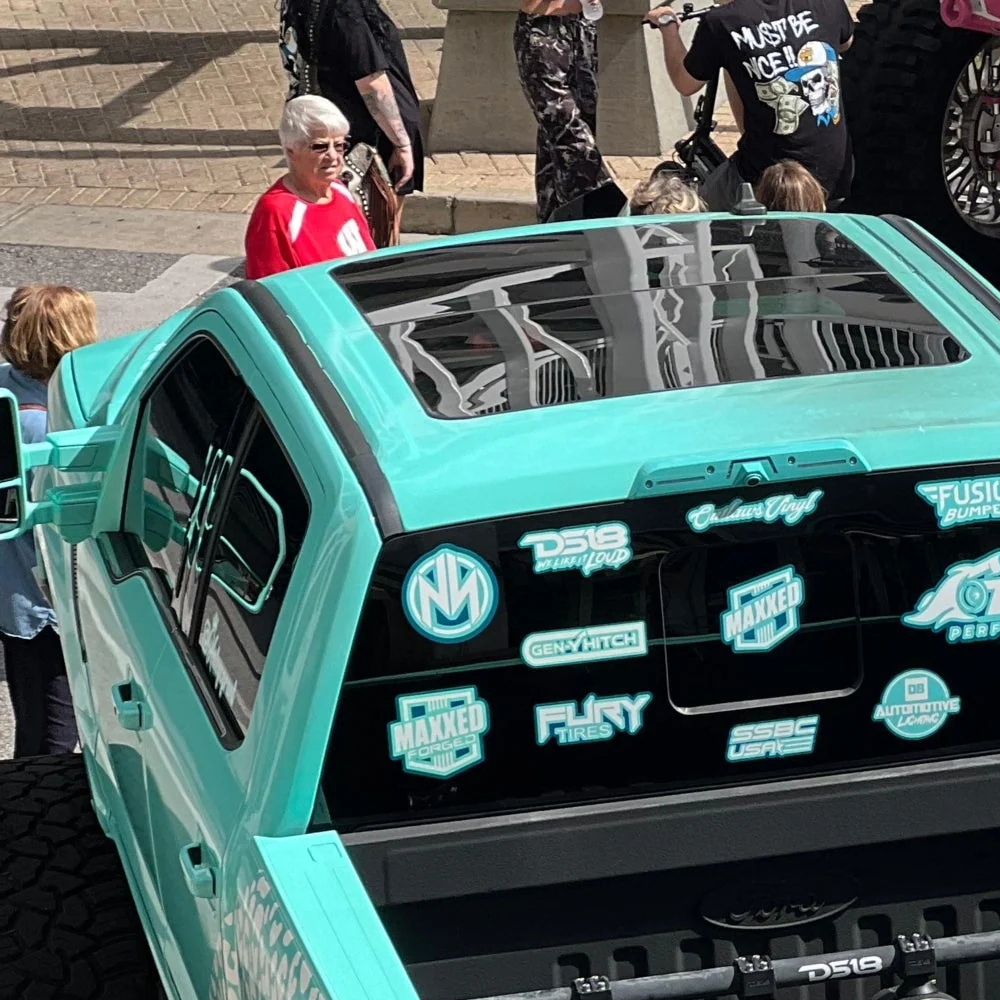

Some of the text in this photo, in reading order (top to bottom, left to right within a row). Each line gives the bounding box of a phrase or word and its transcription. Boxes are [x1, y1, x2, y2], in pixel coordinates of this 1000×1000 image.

[787, 10, 820, 38] BE
[584, 549, 630, 572] LOUD
[725, 581, 801, 640] MAXXED
[537, 695, 650, 743] FURY
[875, 697, 960, 718] AUTOMOTIVE
[395, 703, 485, 753] MAXXED
[555, 723, 611, 742] TIRES
[733, 717, 818, 744] SSBC
[407, 733, 477, 760] FORGED
[728, 741, 777, 759] USA
